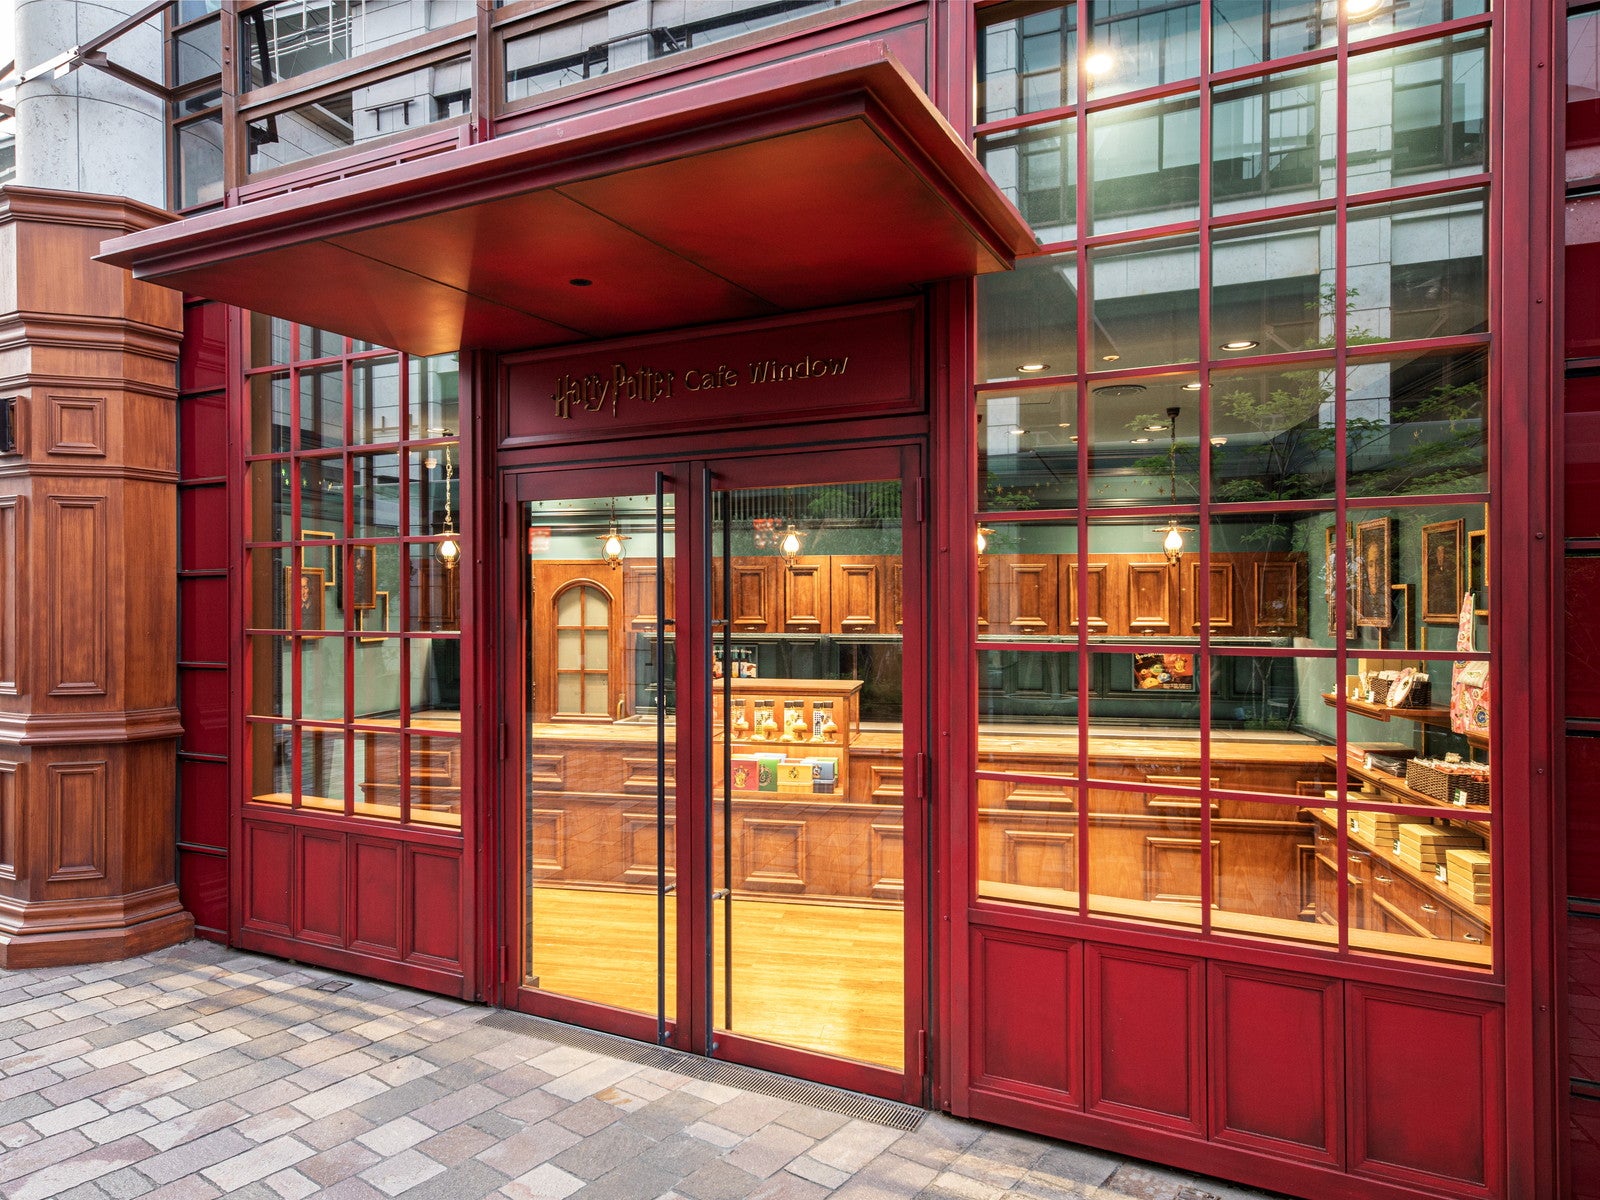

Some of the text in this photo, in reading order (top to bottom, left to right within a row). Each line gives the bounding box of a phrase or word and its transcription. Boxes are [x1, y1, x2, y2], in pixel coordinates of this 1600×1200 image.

[551, 355, 848, 418] Harry Potter Cafe Window
